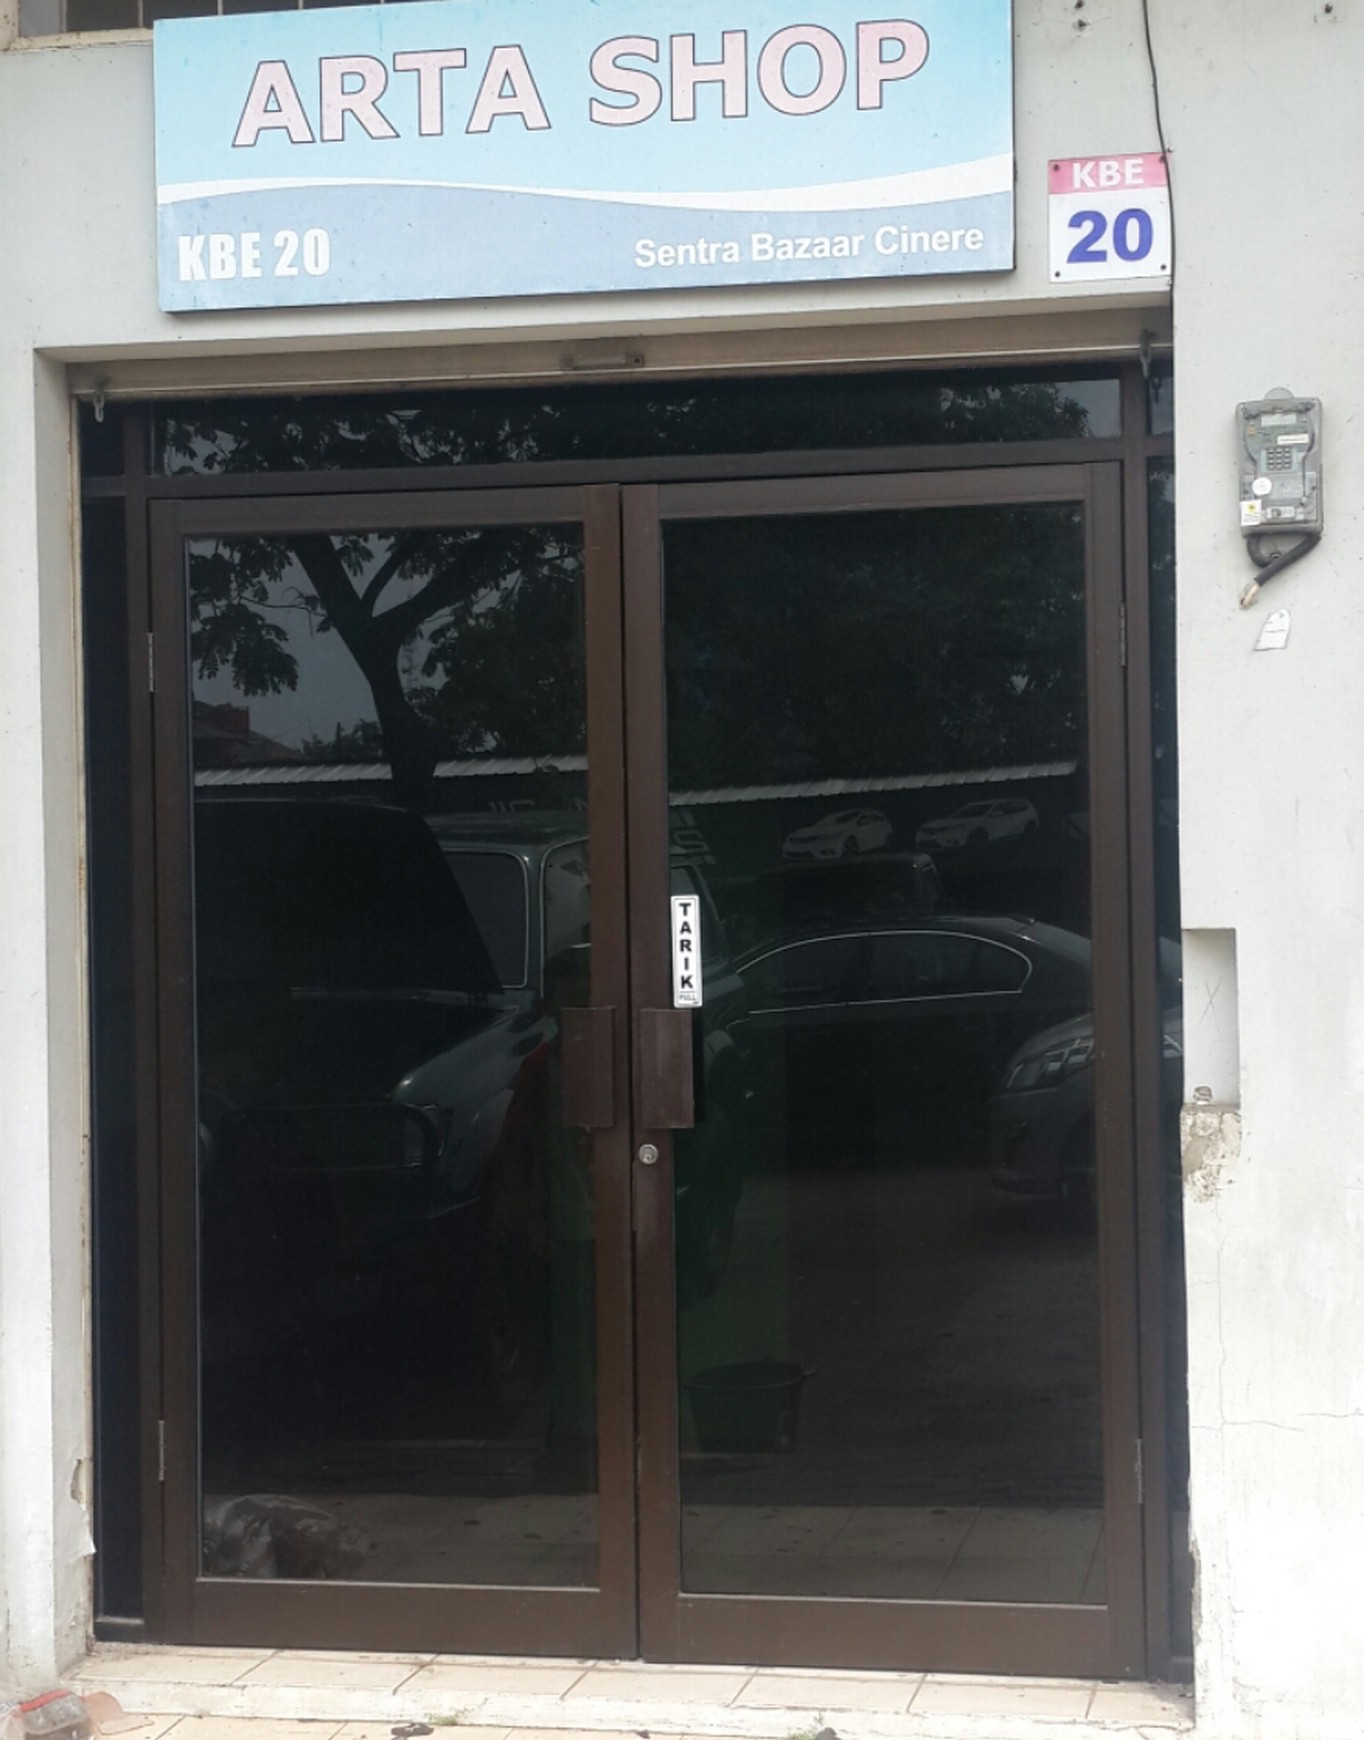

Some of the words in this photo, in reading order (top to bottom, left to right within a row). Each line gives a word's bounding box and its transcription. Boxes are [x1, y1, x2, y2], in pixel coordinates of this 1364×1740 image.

[232, 45, 551, 147] ARTA
[589, 19, 929, 126] SHOP
[1072, 158, 1145, 189] KBE
[178, 232, 262, 281] KBE
[273, 228, 331, 276] 20
[633, 237, 740, 269] Sentra
[750, 233, 865, 263] Bazaar
[874, 225, 985, 255] Cinere
[1066, 208, 1153, 264] 20
[678, 902, 693, 989] TARIK
[680, 993, 696, 1001] PULL
